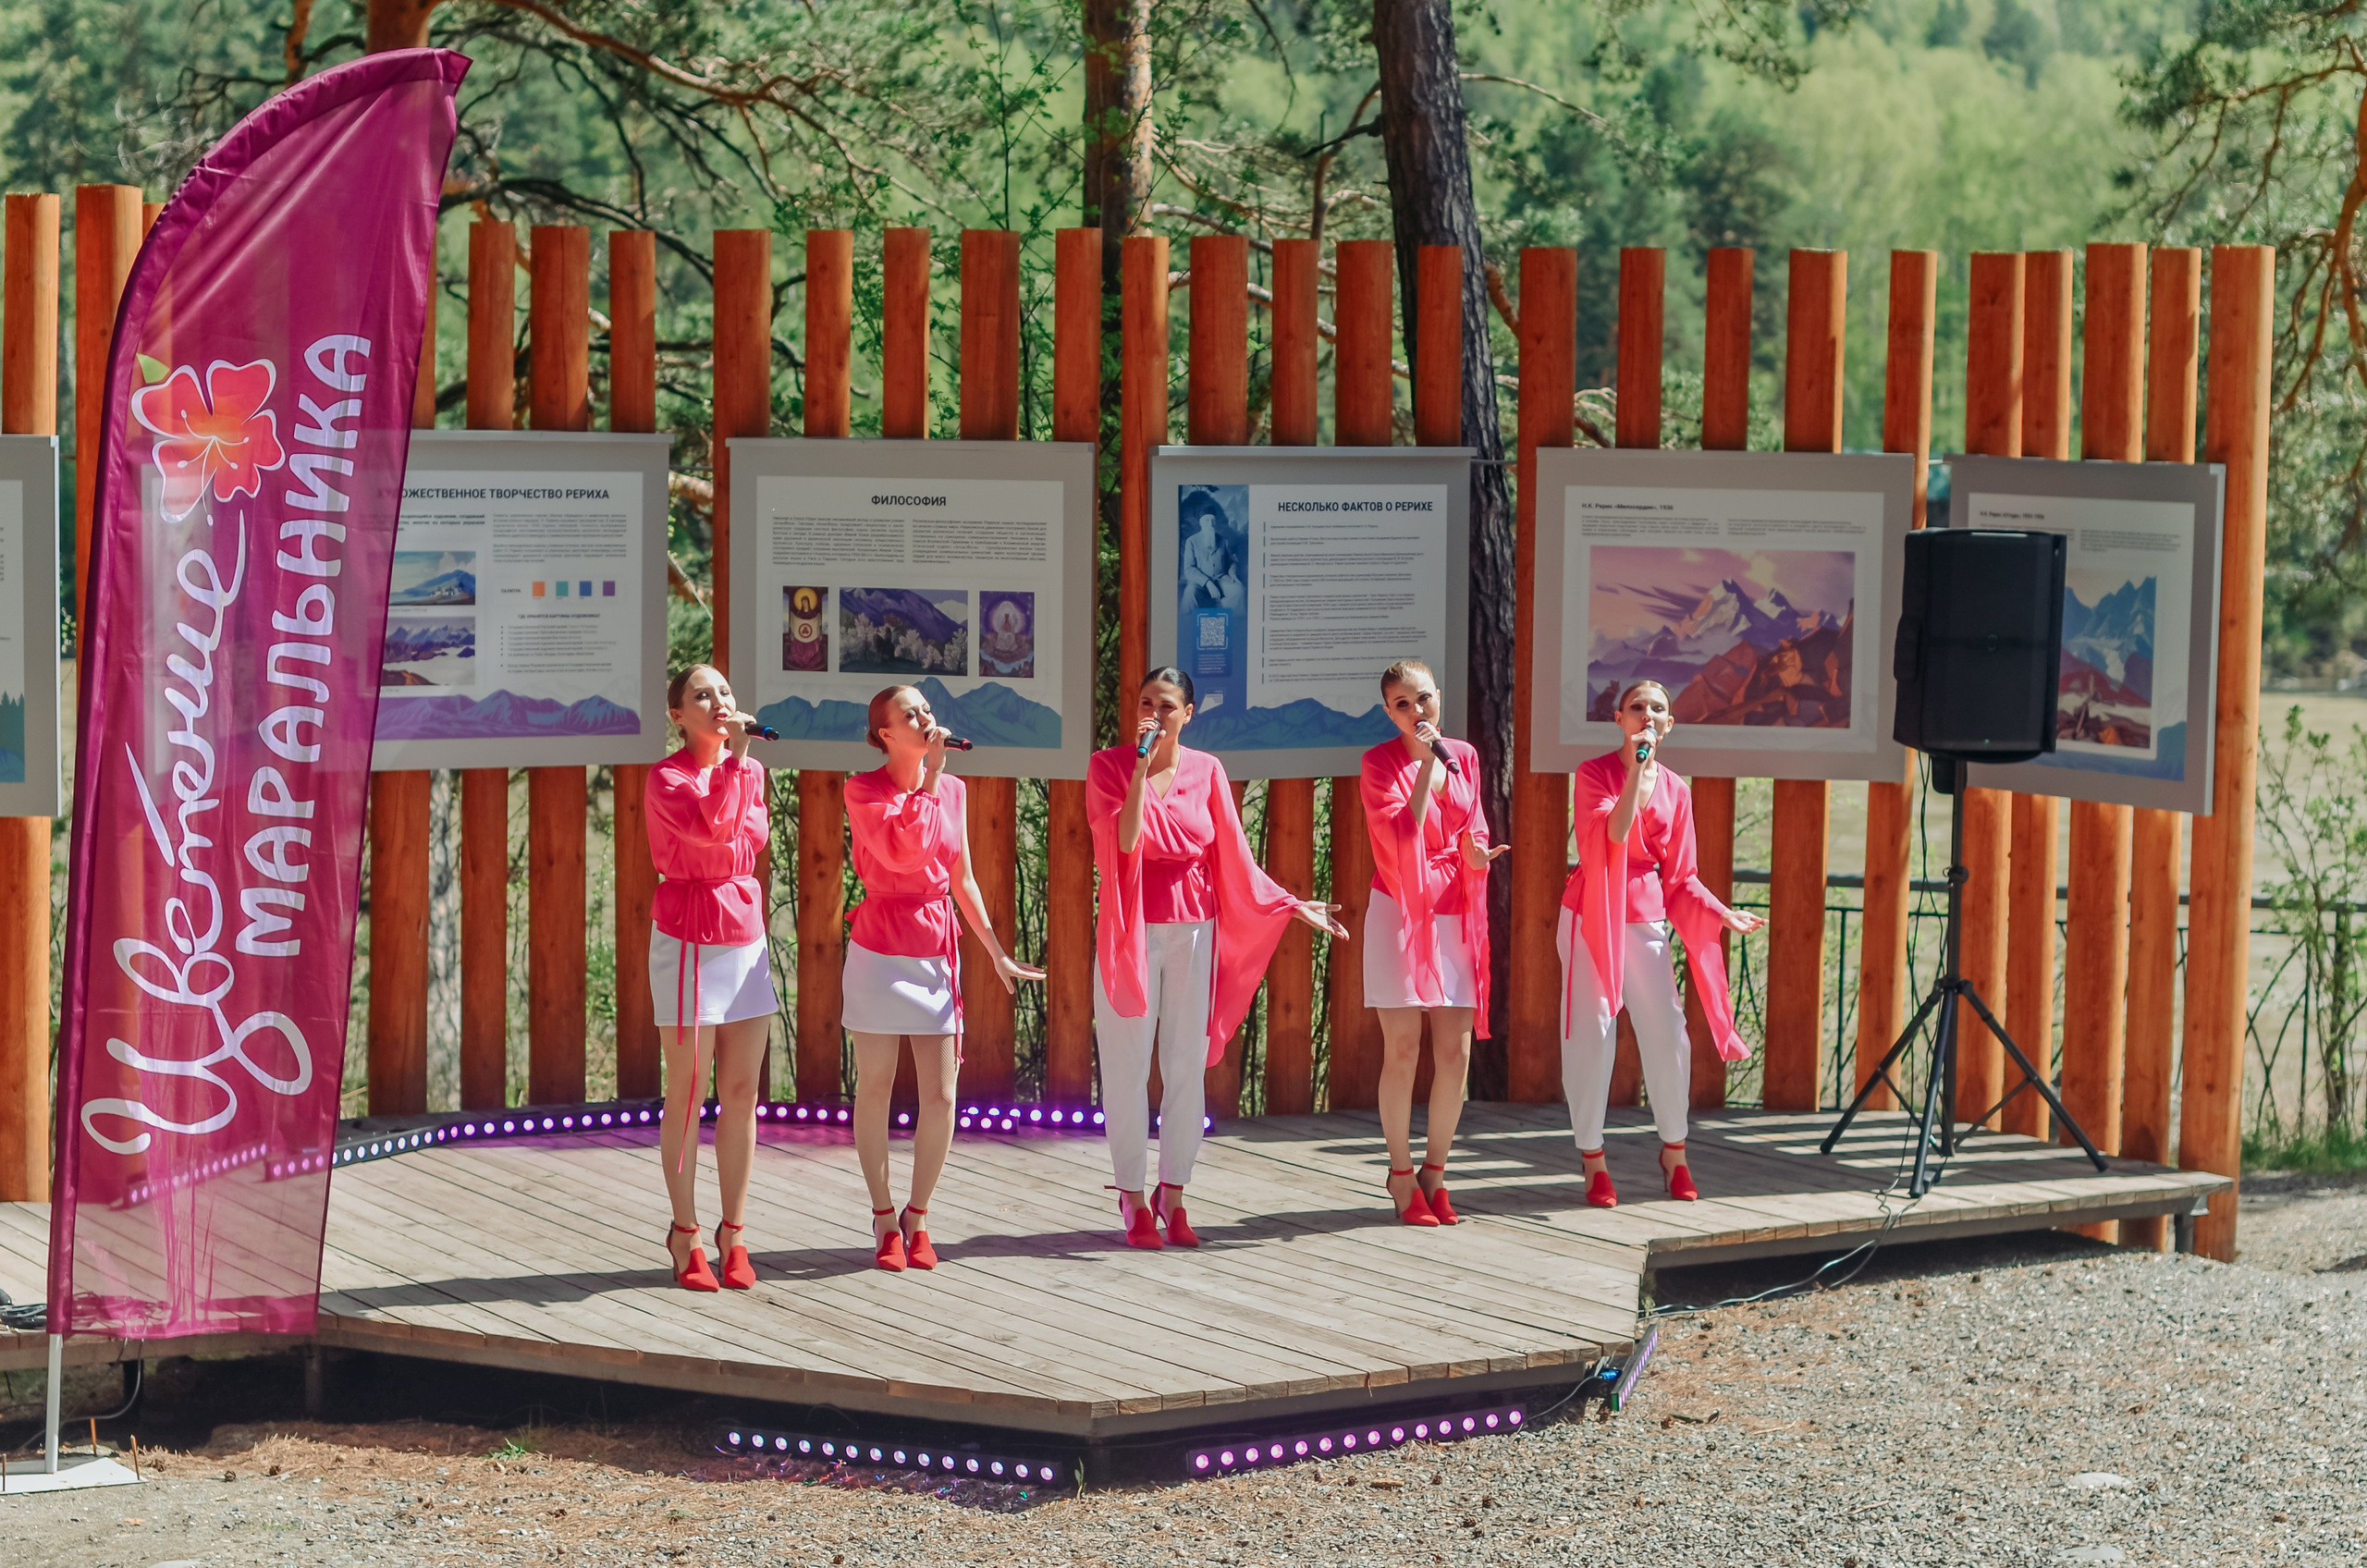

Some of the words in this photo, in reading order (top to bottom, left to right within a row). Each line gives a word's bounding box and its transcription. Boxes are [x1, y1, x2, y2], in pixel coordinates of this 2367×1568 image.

[489, 488, 563, 499] ТВОРЧЕСТВО
[565, 489, 610, 499] РЕРИХА
[871, 495, 947, 507] ФИЛОСОФИЯ
[1278, 501, 1339, 512] НЕСКОЛЬКО
[1342, 501, 1383, 512] ФАКТОВ
[1385, 502, 1392, 511] О
[1394, 501, 1433, 511] РЕРИХЕ
[236, 333, 371, 957] МАРАЛЬНИКА
